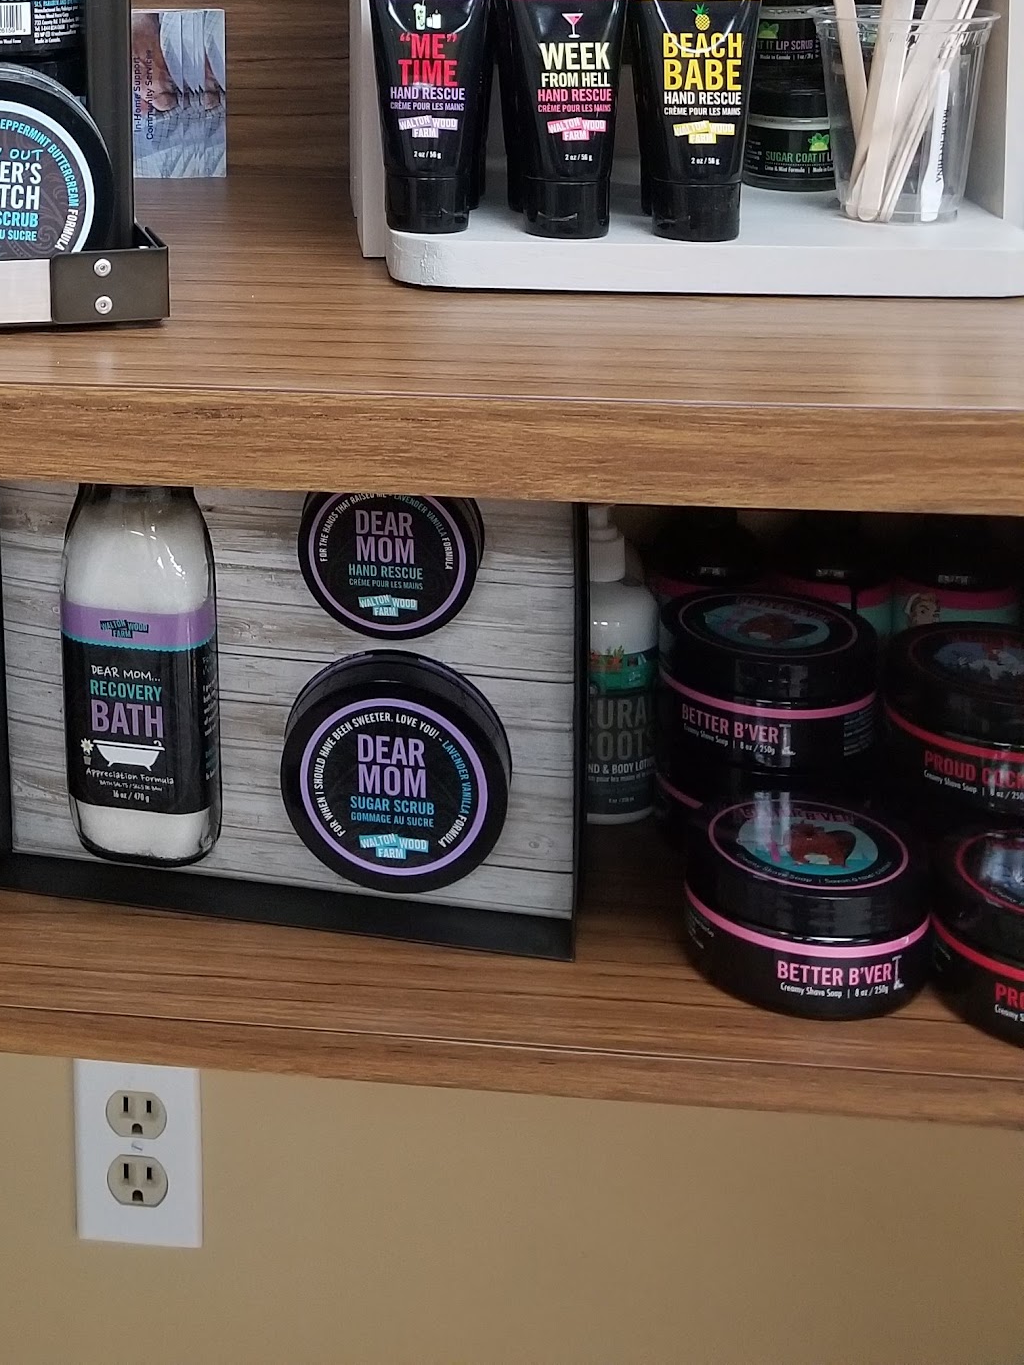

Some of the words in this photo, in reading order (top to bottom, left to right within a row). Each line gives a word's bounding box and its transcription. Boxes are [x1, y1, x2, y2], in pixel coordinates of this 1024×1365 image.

[538, 42, 610, 70] WEEK
[663, 33, 743, 59] BEACH
[776, 40, 790, 50] LIP
[791, 39, 814, 50] SCRUB
[398, 59, 457, 87] TIME
[542, 72, 580, 87] FROM
[582, 72, 610, 87] HELL
[663, 59, 742, 91] BABE
[390, 86, 420, 100] HAND
[422, 87, 465, 101] RESCUE
[537, 89, 569, 102] HAND
[572, 89, 612, 102] RESCUE
[664, 92, 695, 105] HAND
[699, 92, 742, 105] RESCUE
[9, 148, 44, 162] OUT
[765, 152, 794, 163] SUGAR
[795, 152, 817, 162] COAT
[818, 152, 825, 162] IT
[355, 509, 413, 537] DEAR
[356, 536, 415, 565] MOM
[349, 563, 377, 576] HAND
[381, 565, 423, 580] RESCUE
[91, 664, 120, 678] DEAR
[90, 679, 162, 702] RECOVERY
[91, 699, 164, 739] BATH
[682, 704, 729, 735] BETTER
[734, 721, 779, 744] B'VER
[357, 733, 425, 767] DEAR
[86, 767, 138, 781] Appreciation
[140, 774, 174, 785] Formula
[924, 750, 976, 781] PROUD
[358, 763, 426, 799] MOM
[350, 796, 390, 812] SUGAR
[393, 800, 435, 816] SCRUB
[777, 960, 843, 987] BETTER
[849, 965, 892, 986] B'VER
